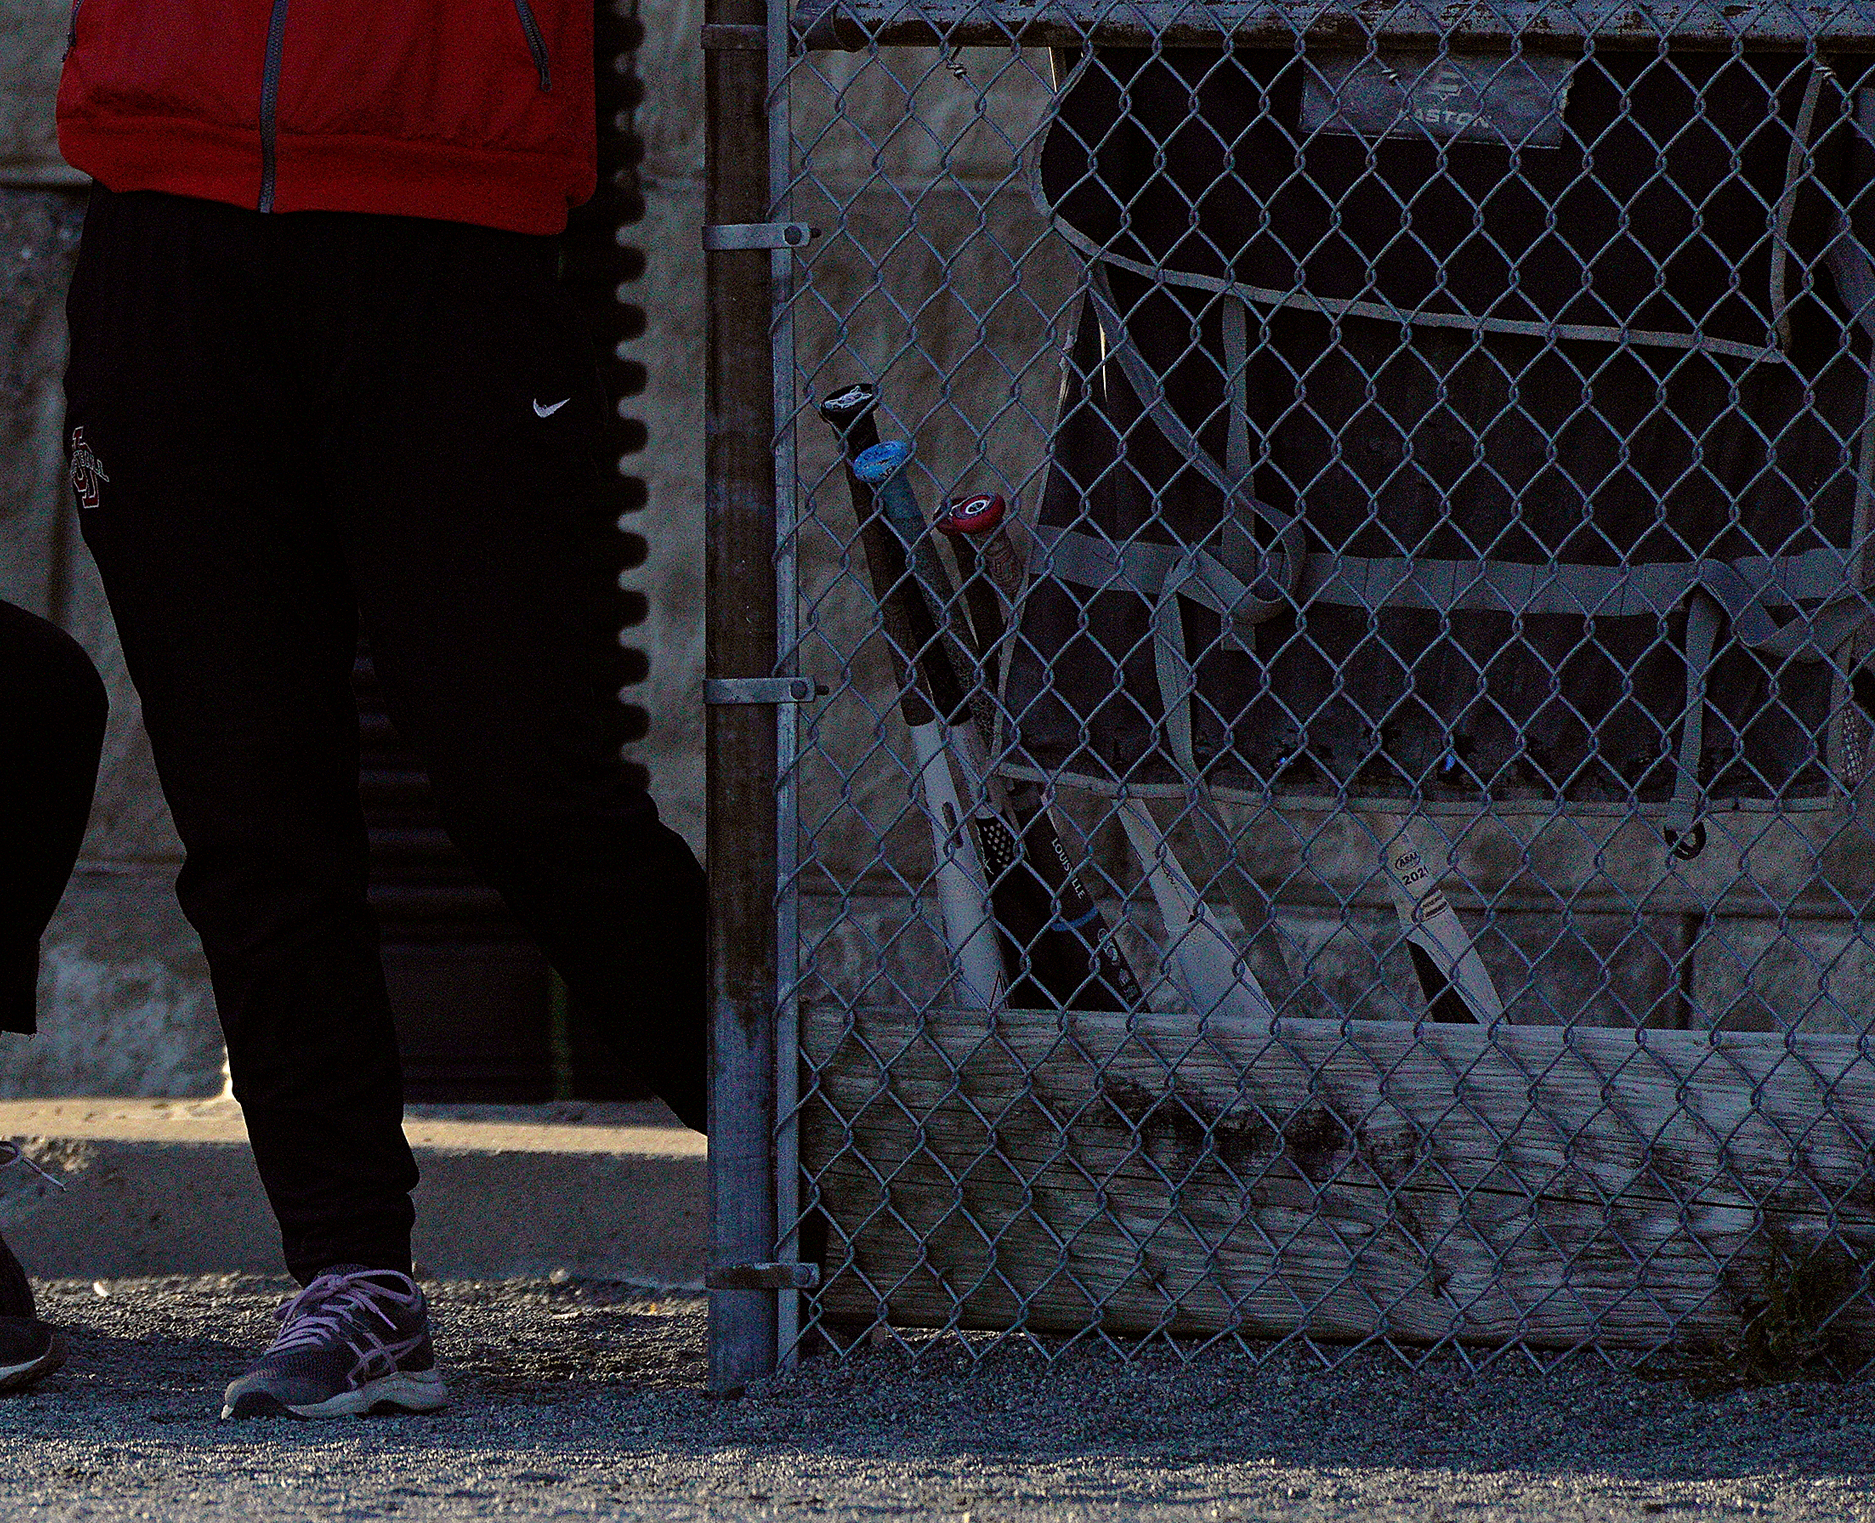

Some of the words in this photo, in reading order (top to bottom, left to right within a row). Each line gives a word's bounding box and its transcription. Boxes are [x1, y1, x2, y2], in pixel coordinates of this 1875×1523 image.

[1397, 108, 1493, 128] ASTON
[1050, 836, 1087, 901] LOUISVLLE
[1401, 865, 1431, 887] 2021
